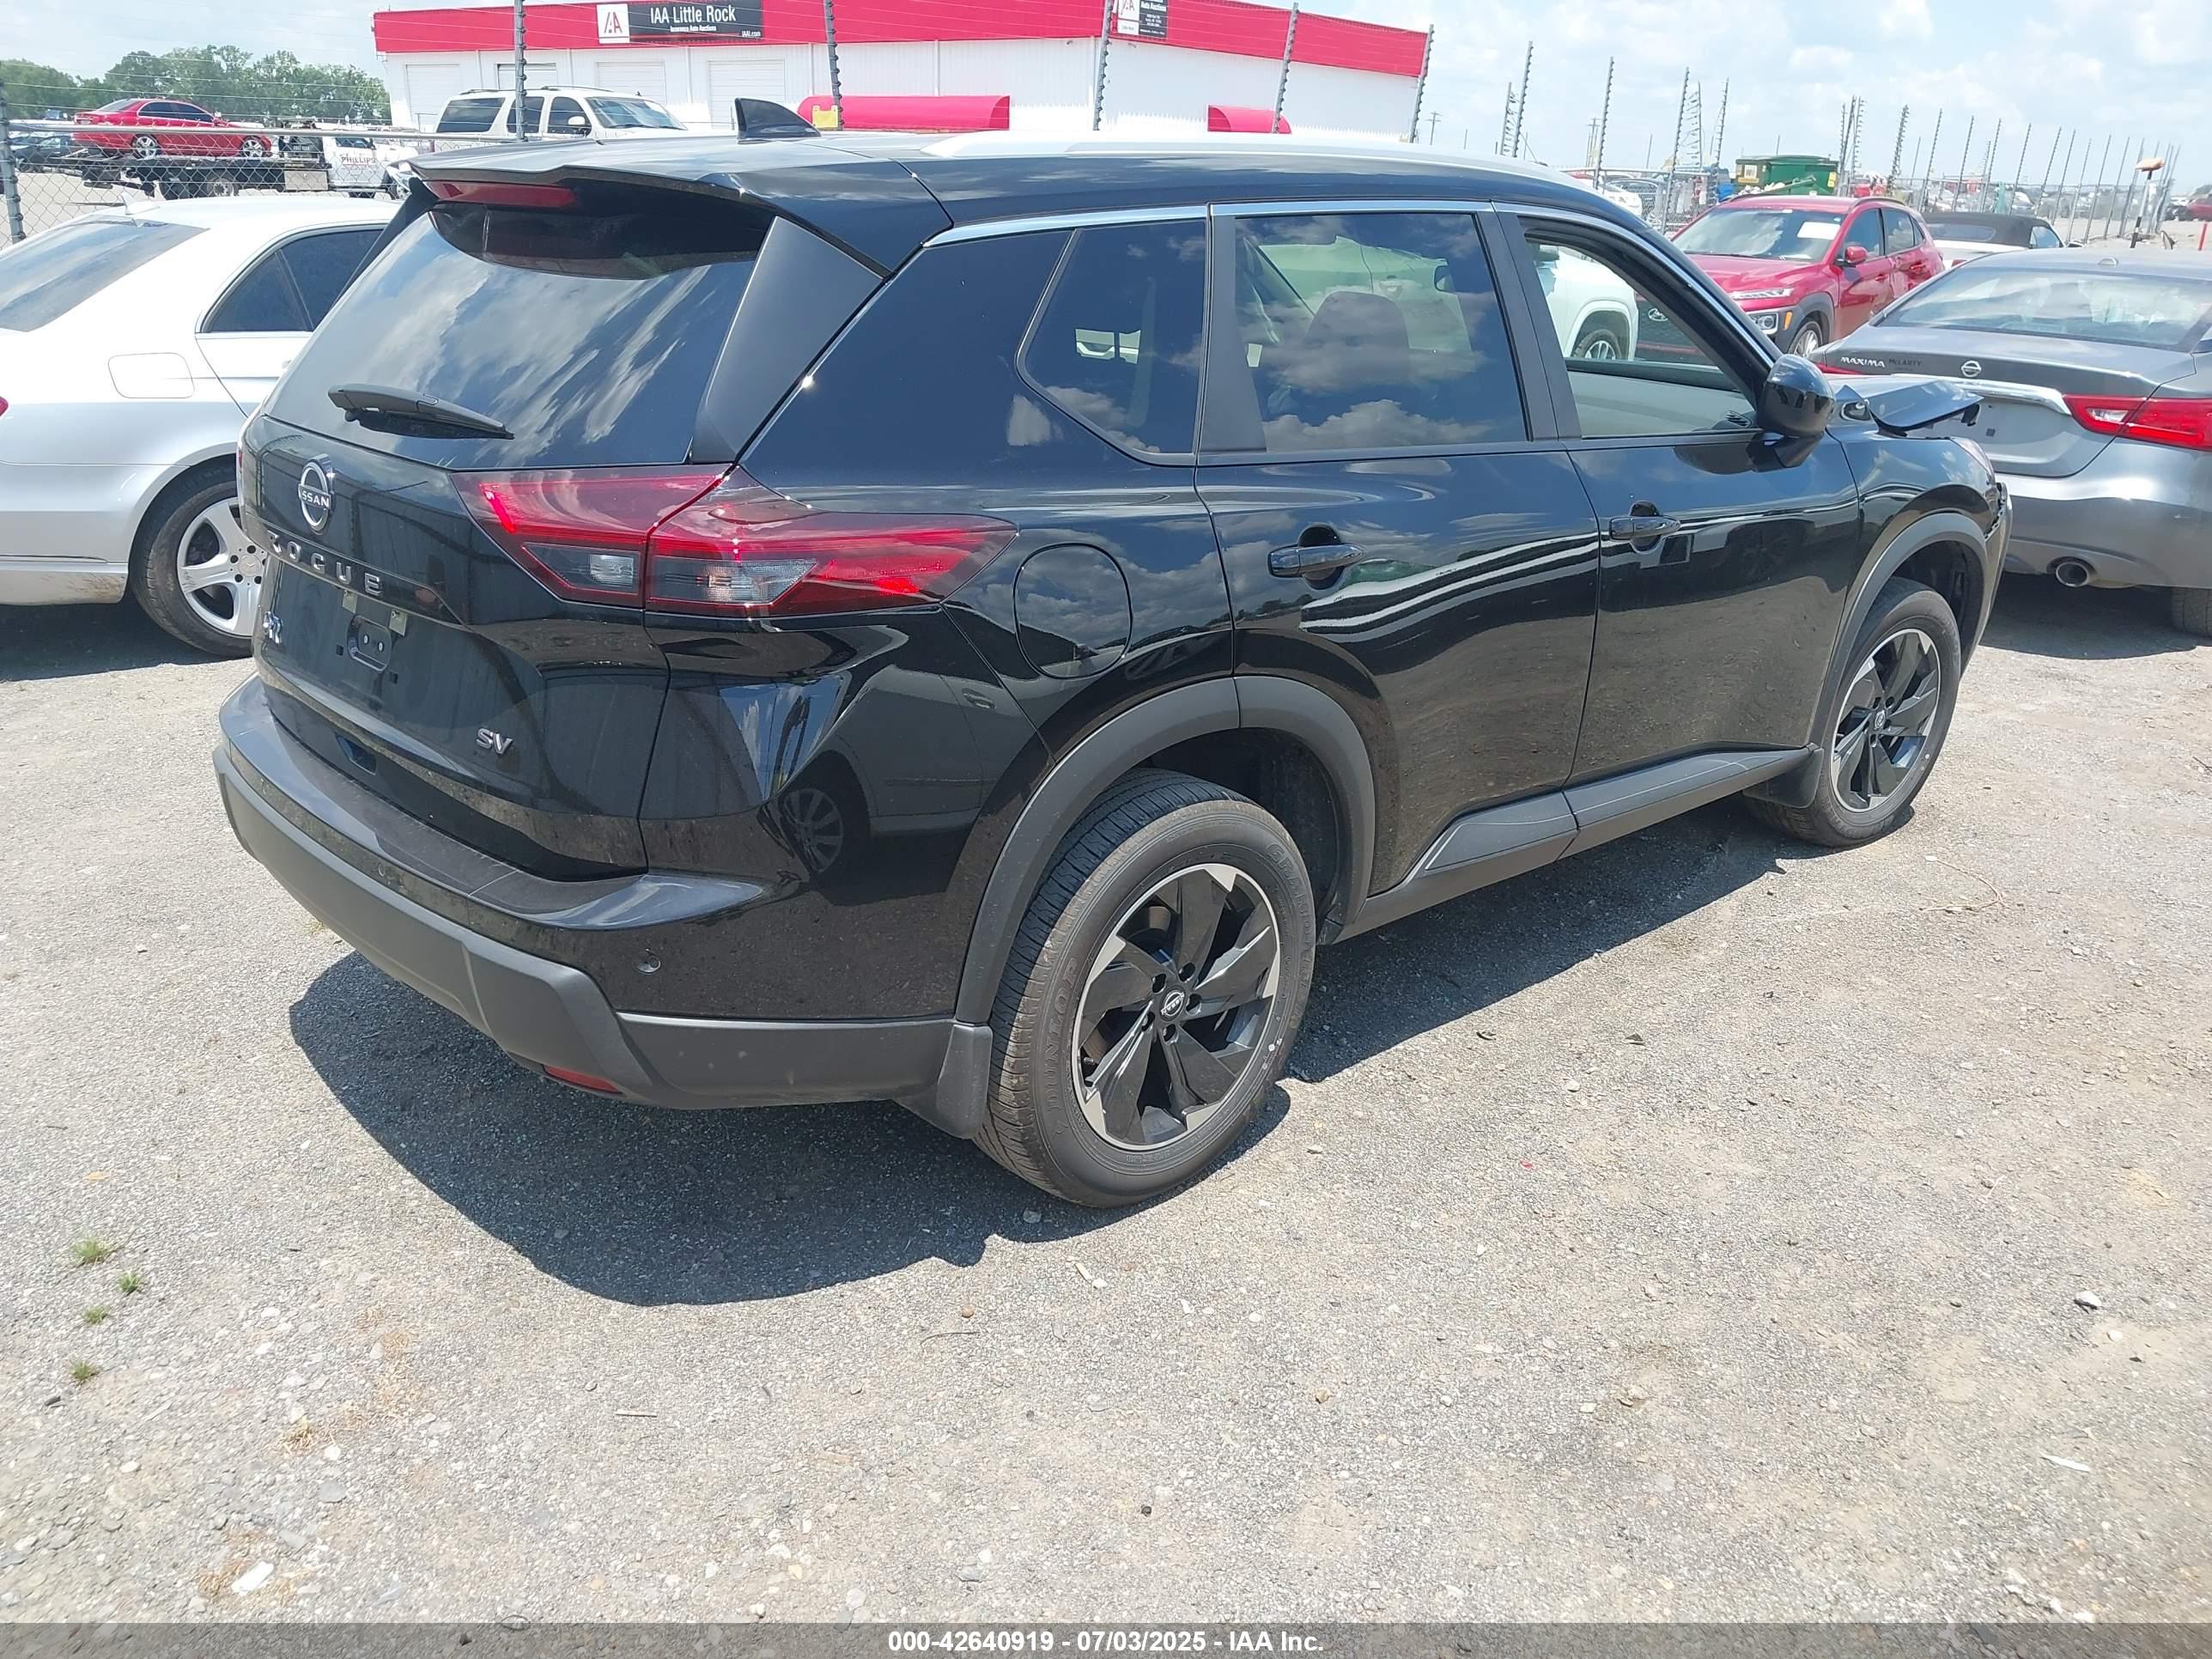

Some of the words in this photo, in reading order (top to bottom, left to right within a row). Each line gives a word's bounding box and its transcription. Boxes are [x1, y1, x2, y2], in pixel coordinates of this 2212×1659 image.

[650, 7, 670, 24] IAA
[673, 6, 702, 24] Little
[706, 4, 737, 23] Rock
[1840, 356, 1886, 368] MAXIMA
[267, 529, 384, 598] ROGUE
[476, 727, 514, 756] SV
[1043, 957, 1079, 1114] DUNLOP
